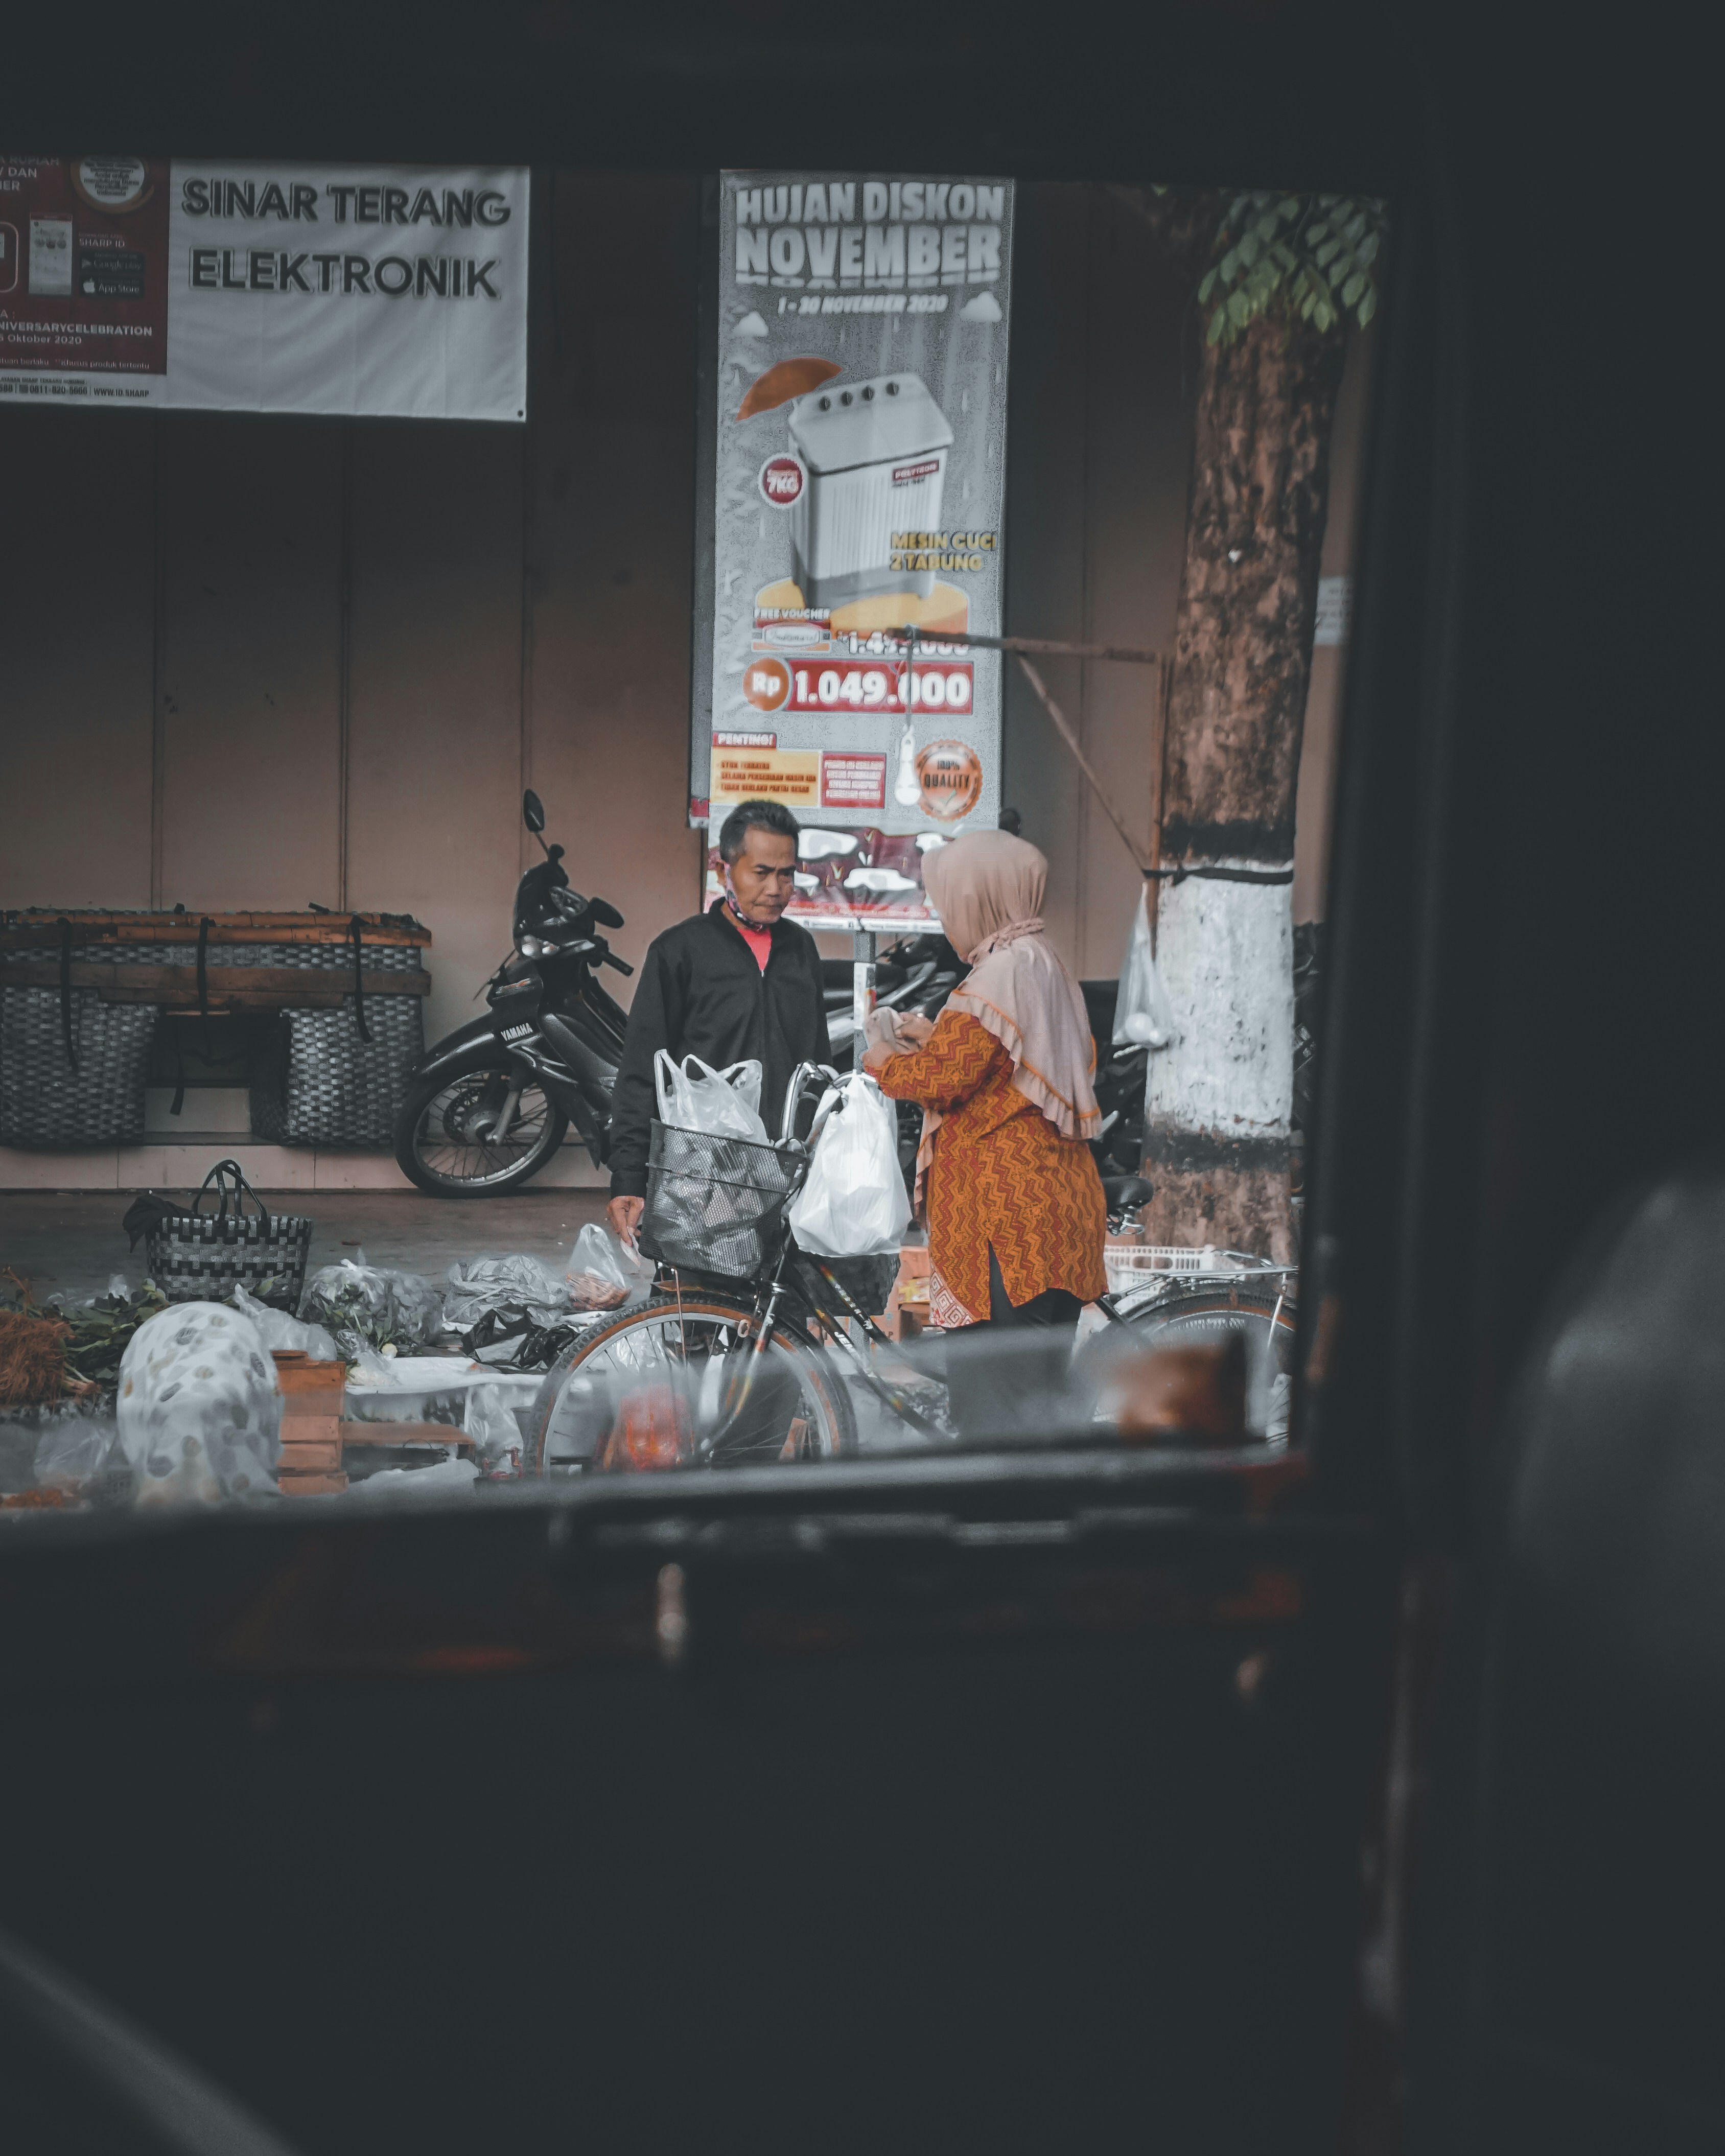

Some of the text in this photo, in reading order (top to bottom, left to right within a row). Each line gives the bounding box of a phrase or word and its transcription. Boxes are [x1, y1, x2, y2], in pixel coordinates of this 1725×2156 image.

[8, 167, 37, 178] DAN
[0, 180, 20, 191] ER
[182, 178, 510, 228] SINAR TERANG
[736, 181, 1005, 224] HUJAN DISKON
[79, 238, 125, 248] SHARP ID
[736, 225, 1001, 281] NOVEMBER
[94, 259, 123, 272] Google
[189, 246, 501, 300] ELEKTRONIK
[98, 283, 139, 294] App Store
[821, 294, 907, 314] NOVEMBER
[907, 294, 949, 314] 2020
[0, 321, 152, 336] NIVERSARYCELEBRATION
[8, 334, 50, 344] Oktober
[54, 336, 82, 344] 2020
[20, 357, 49, 366] berlaku
[90, 360, 116, 369] produk
[119, 361, 150, 369] tertentu
[766, 476, 799, 494] 7KG
[891, 531, 997, 552] MESIN CUCI
[890, 553, 983, 572] 2 TABUNG
[754, 608, 831, 620] FREE VOUCHER
[849, 631, 970, 657] 1.4.000
[752, 669, 971, 706] Rp 1.049.000
[718, 733, 774, 746] PENTING!
[924, 774, 970, 789] QUALITY
[500, 1022, 533, 1041] YAMAHA
